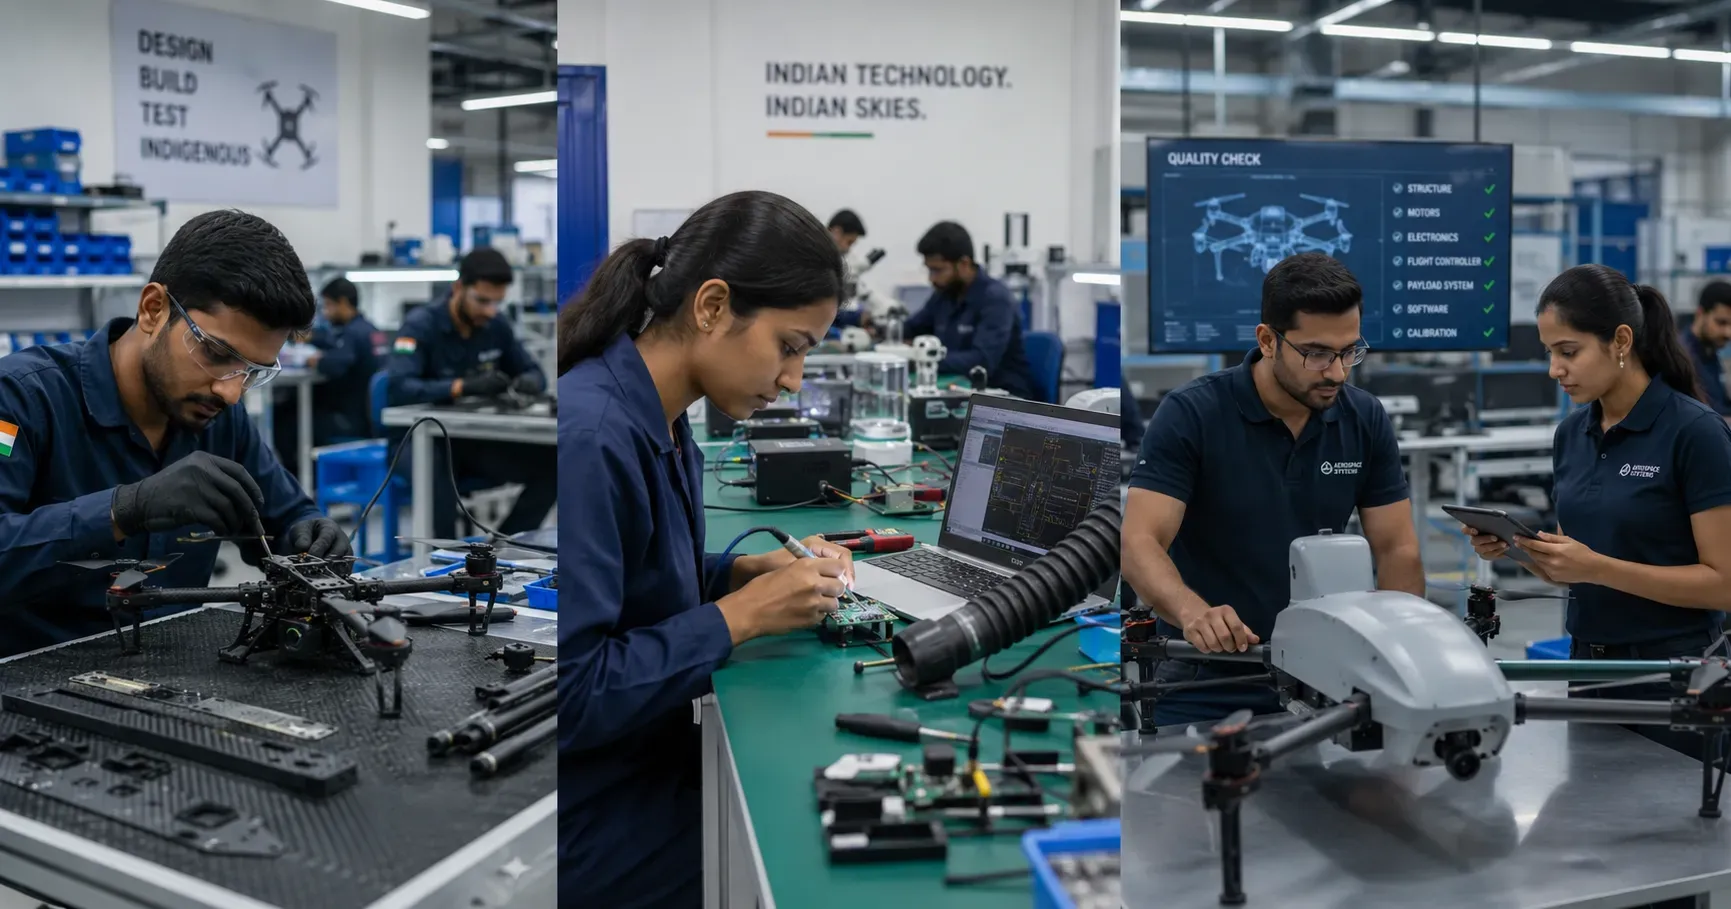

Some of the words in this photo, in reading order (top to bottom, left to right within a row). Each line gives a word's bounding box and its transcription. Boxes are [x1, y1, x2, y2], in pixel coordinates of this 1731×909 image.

[138, 28, 214, 64] DESIGN
[139, 65, 199, 95] BUILD
[765, 62, 847, 84] INDIAN
[855, 63, 1012, 89] TECHNOLOGY.
[765, 95, 847, 118] INDIAN
[855, 97, 926, 120] SKIES.
[139, 101, 188, 129] TEST
[140, 137, 252, 167] INDIGENOUS
[1167, 152, 1219, 166] QUALITY
[1221, 153, 1262, 166] CHECK
[1407, 183, 1453, 194] STRUCTURE
[1407, 208, 1441, 218] MOTORS
[1407, 232, 1459, 242] ELECTRONICS
[1407, 256, 1434, 266] FLIGHT
[1435, 256, 1482, 266] CONTROLLER
[1407, 281, 1442, 290] PAYLOAD
[1443, 280, 1474, 290] SYSTEM
[1407, 304, 1449, 314] SOFTWARE
[1407, 328, 1458, 338] CALIBRATION
